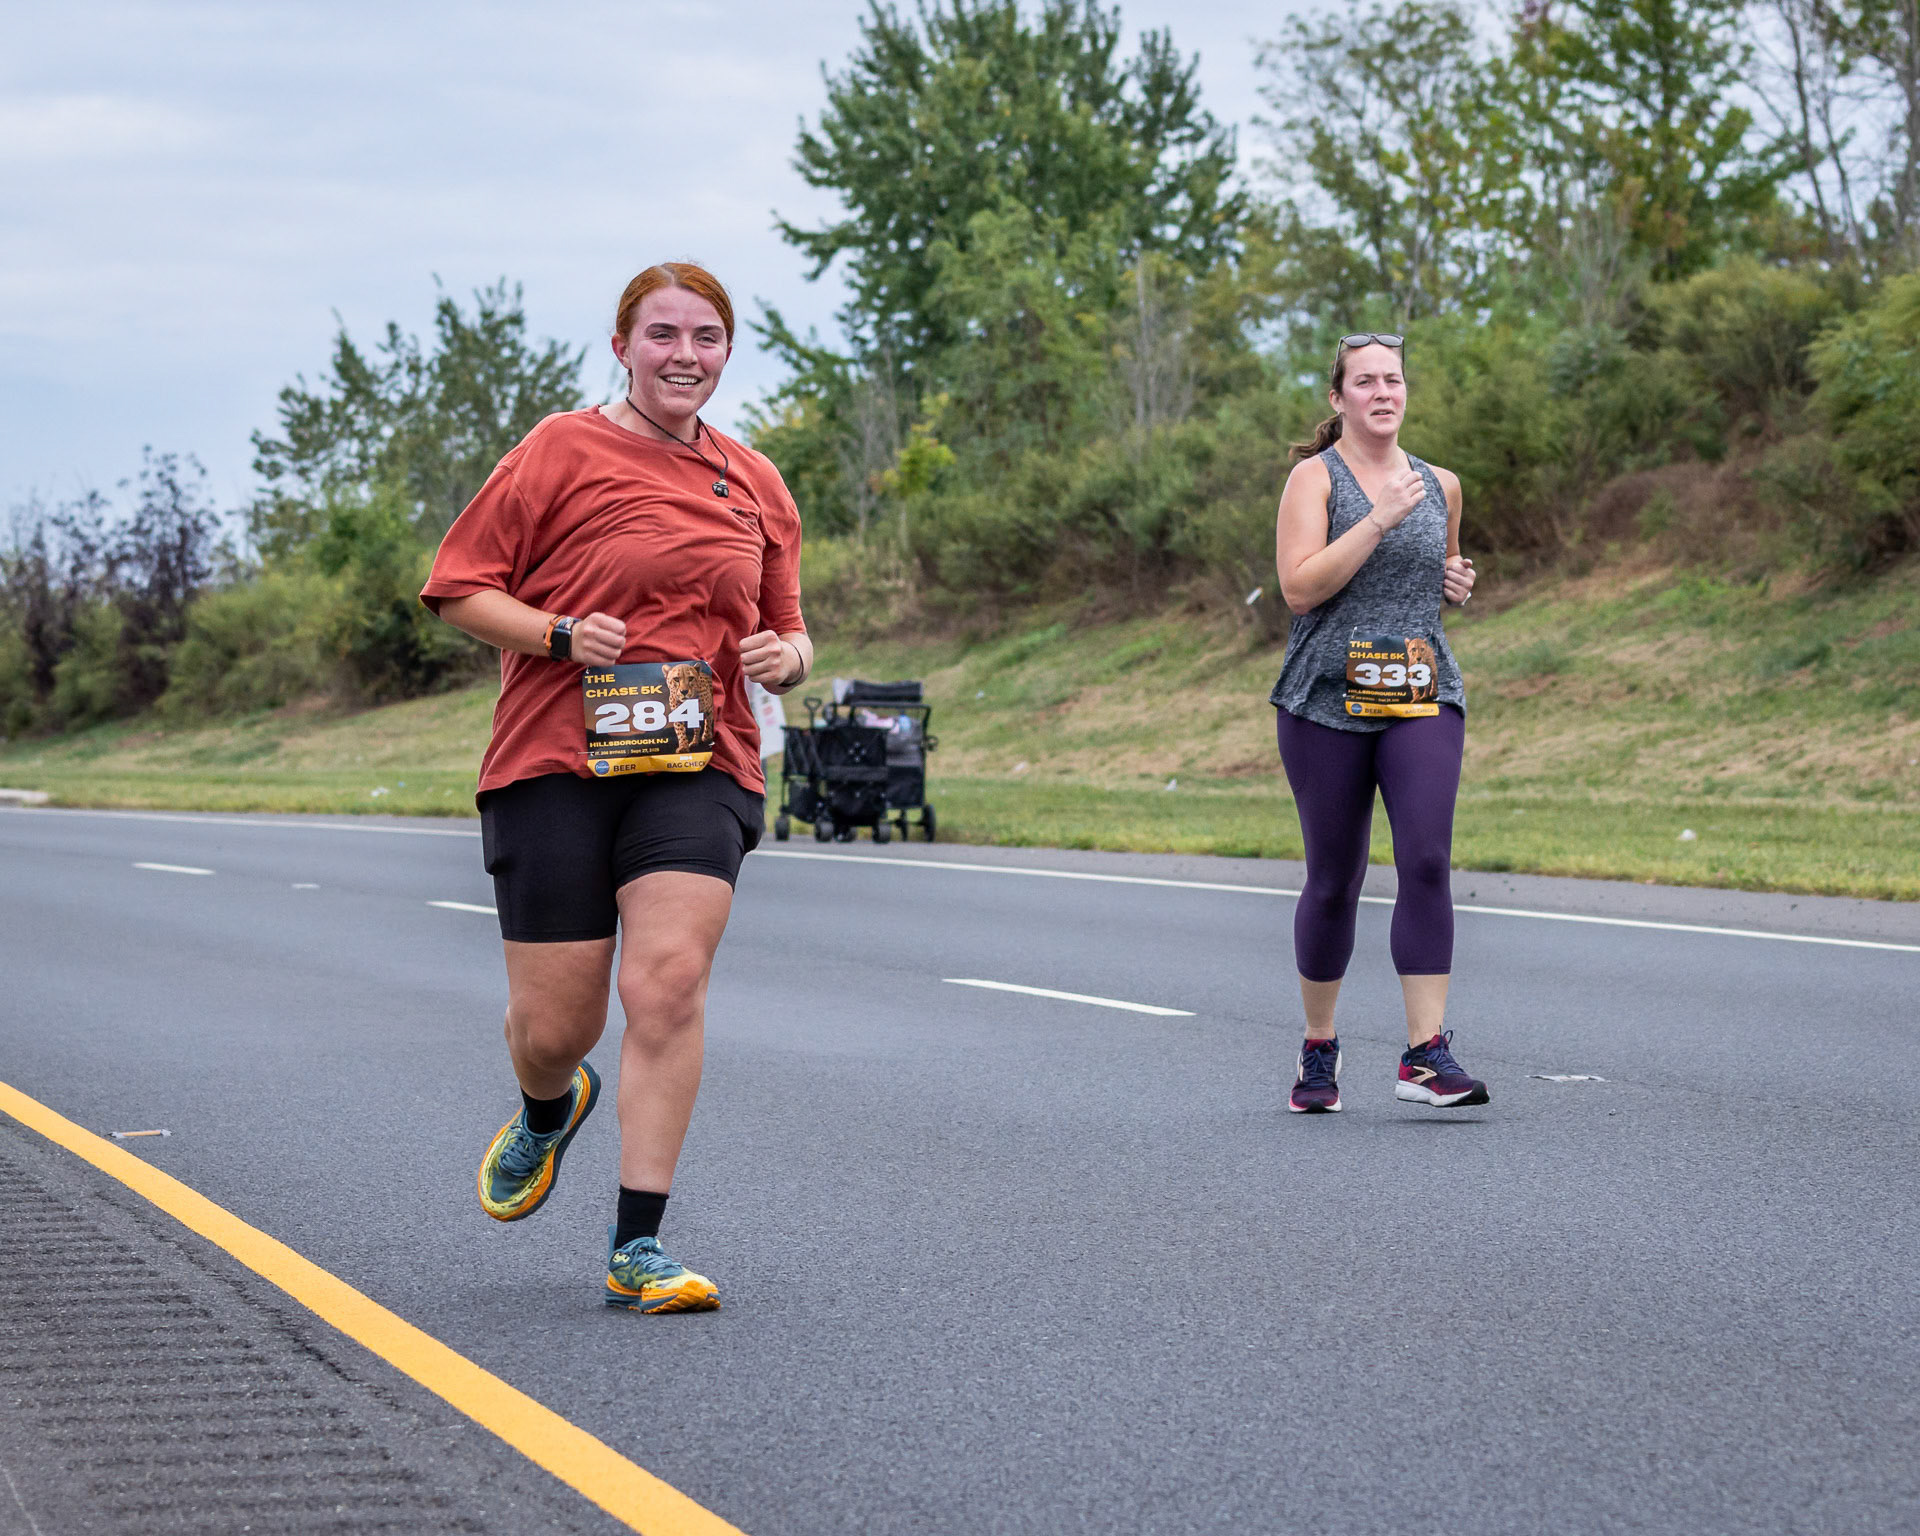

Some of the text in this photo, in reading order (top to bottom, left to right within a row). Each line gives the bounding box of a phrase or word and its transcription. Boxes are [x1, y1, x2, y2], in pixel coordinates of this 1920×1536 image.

[1349, 640, 1373, 649] THE
[1349, 652, 1388, 660] CHASE
[584, 673, 616, 684] THE
[1354, 663, 1431, 687] 333
[585, 685, 663, 698] CHASE 5K
[594, 698, 704, 734] 284
[613, 764, 636, 772] BEER
[667, 761, 682, 769] BAG
